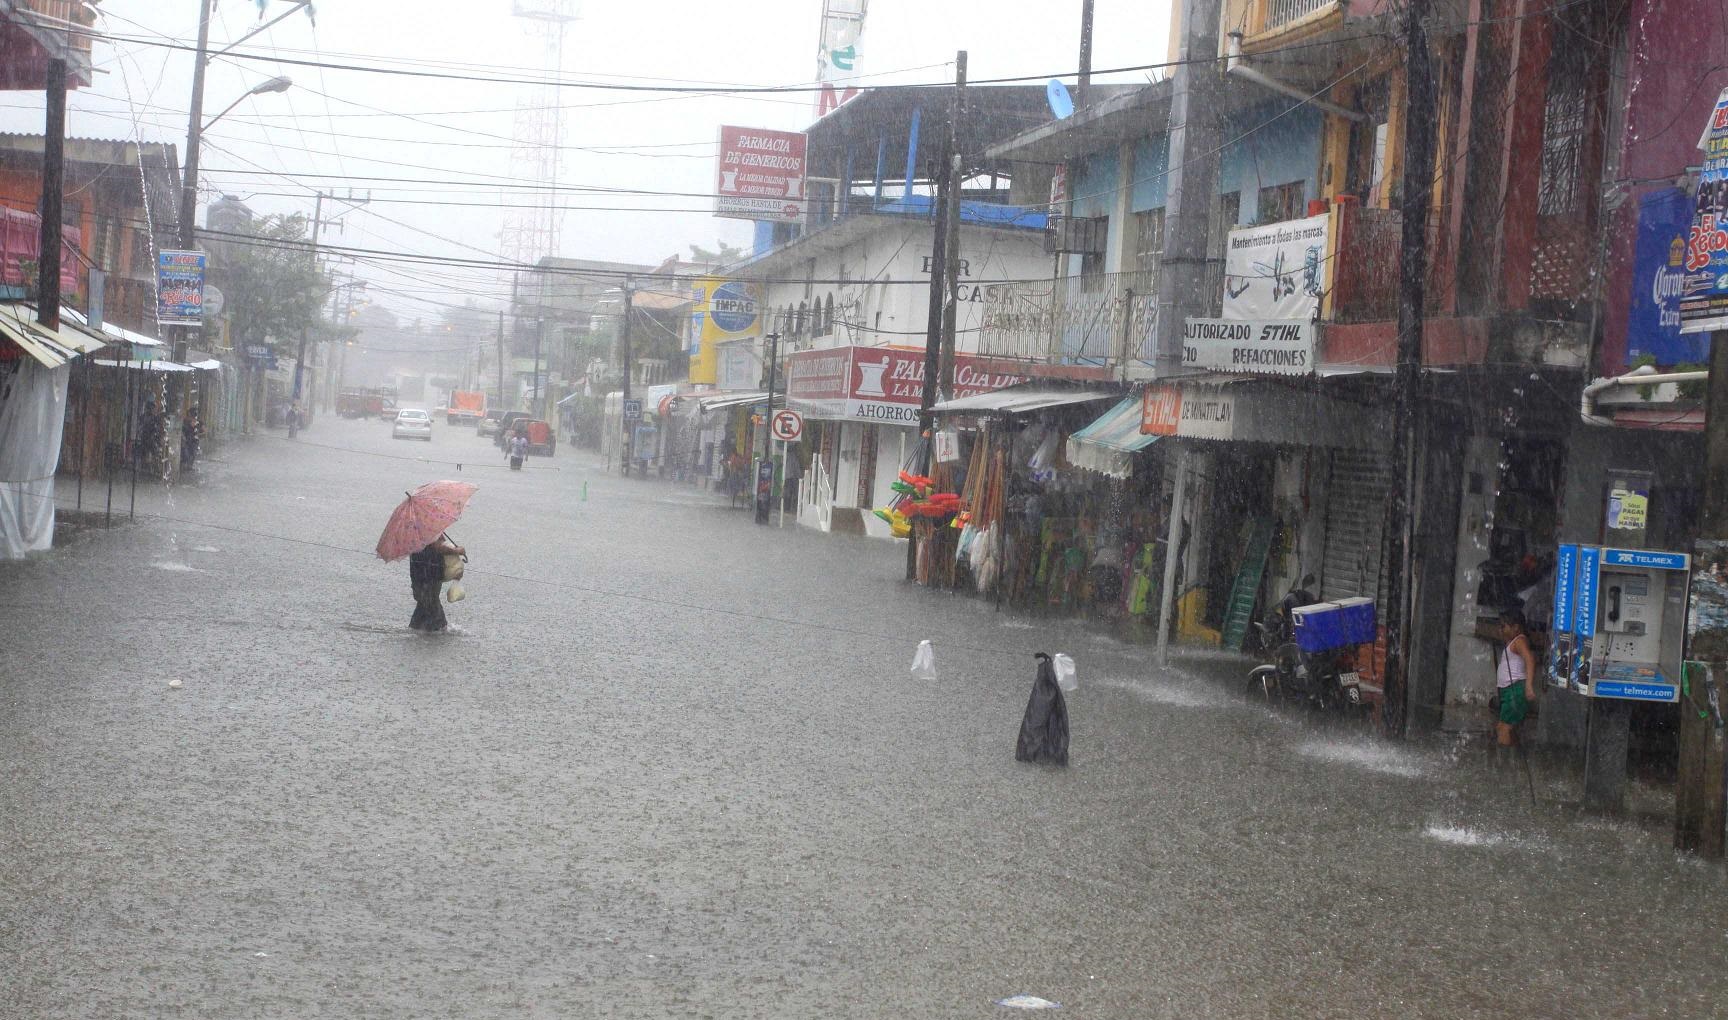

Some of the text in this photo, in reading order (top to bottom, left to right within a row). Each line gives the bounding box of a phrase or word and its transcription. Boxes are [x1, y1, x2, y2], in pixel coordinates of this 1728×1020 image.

[737, 135, 790, 153] FARMACIA
[725, 151, 800, 170] DE GENERICOS
[1302, 226, 1323, 240] marcas
[1686, 227, 1728, 271] Reco
[1653, 264, 1685, 305] Coron
[1658, 301, 1680, 327] Extra
[1184, 323, 1302, 341] AUTORIZADO STIHL
[1232, 348, 1307, 366] REFACCIONES
[856, 403, 921, 422] AHORROS
[1143, 392, 1177, 426] STIHL
[1635, 555, 1673, 565] TELMEX
[1623, 686, 1673, 698] telmex.com
